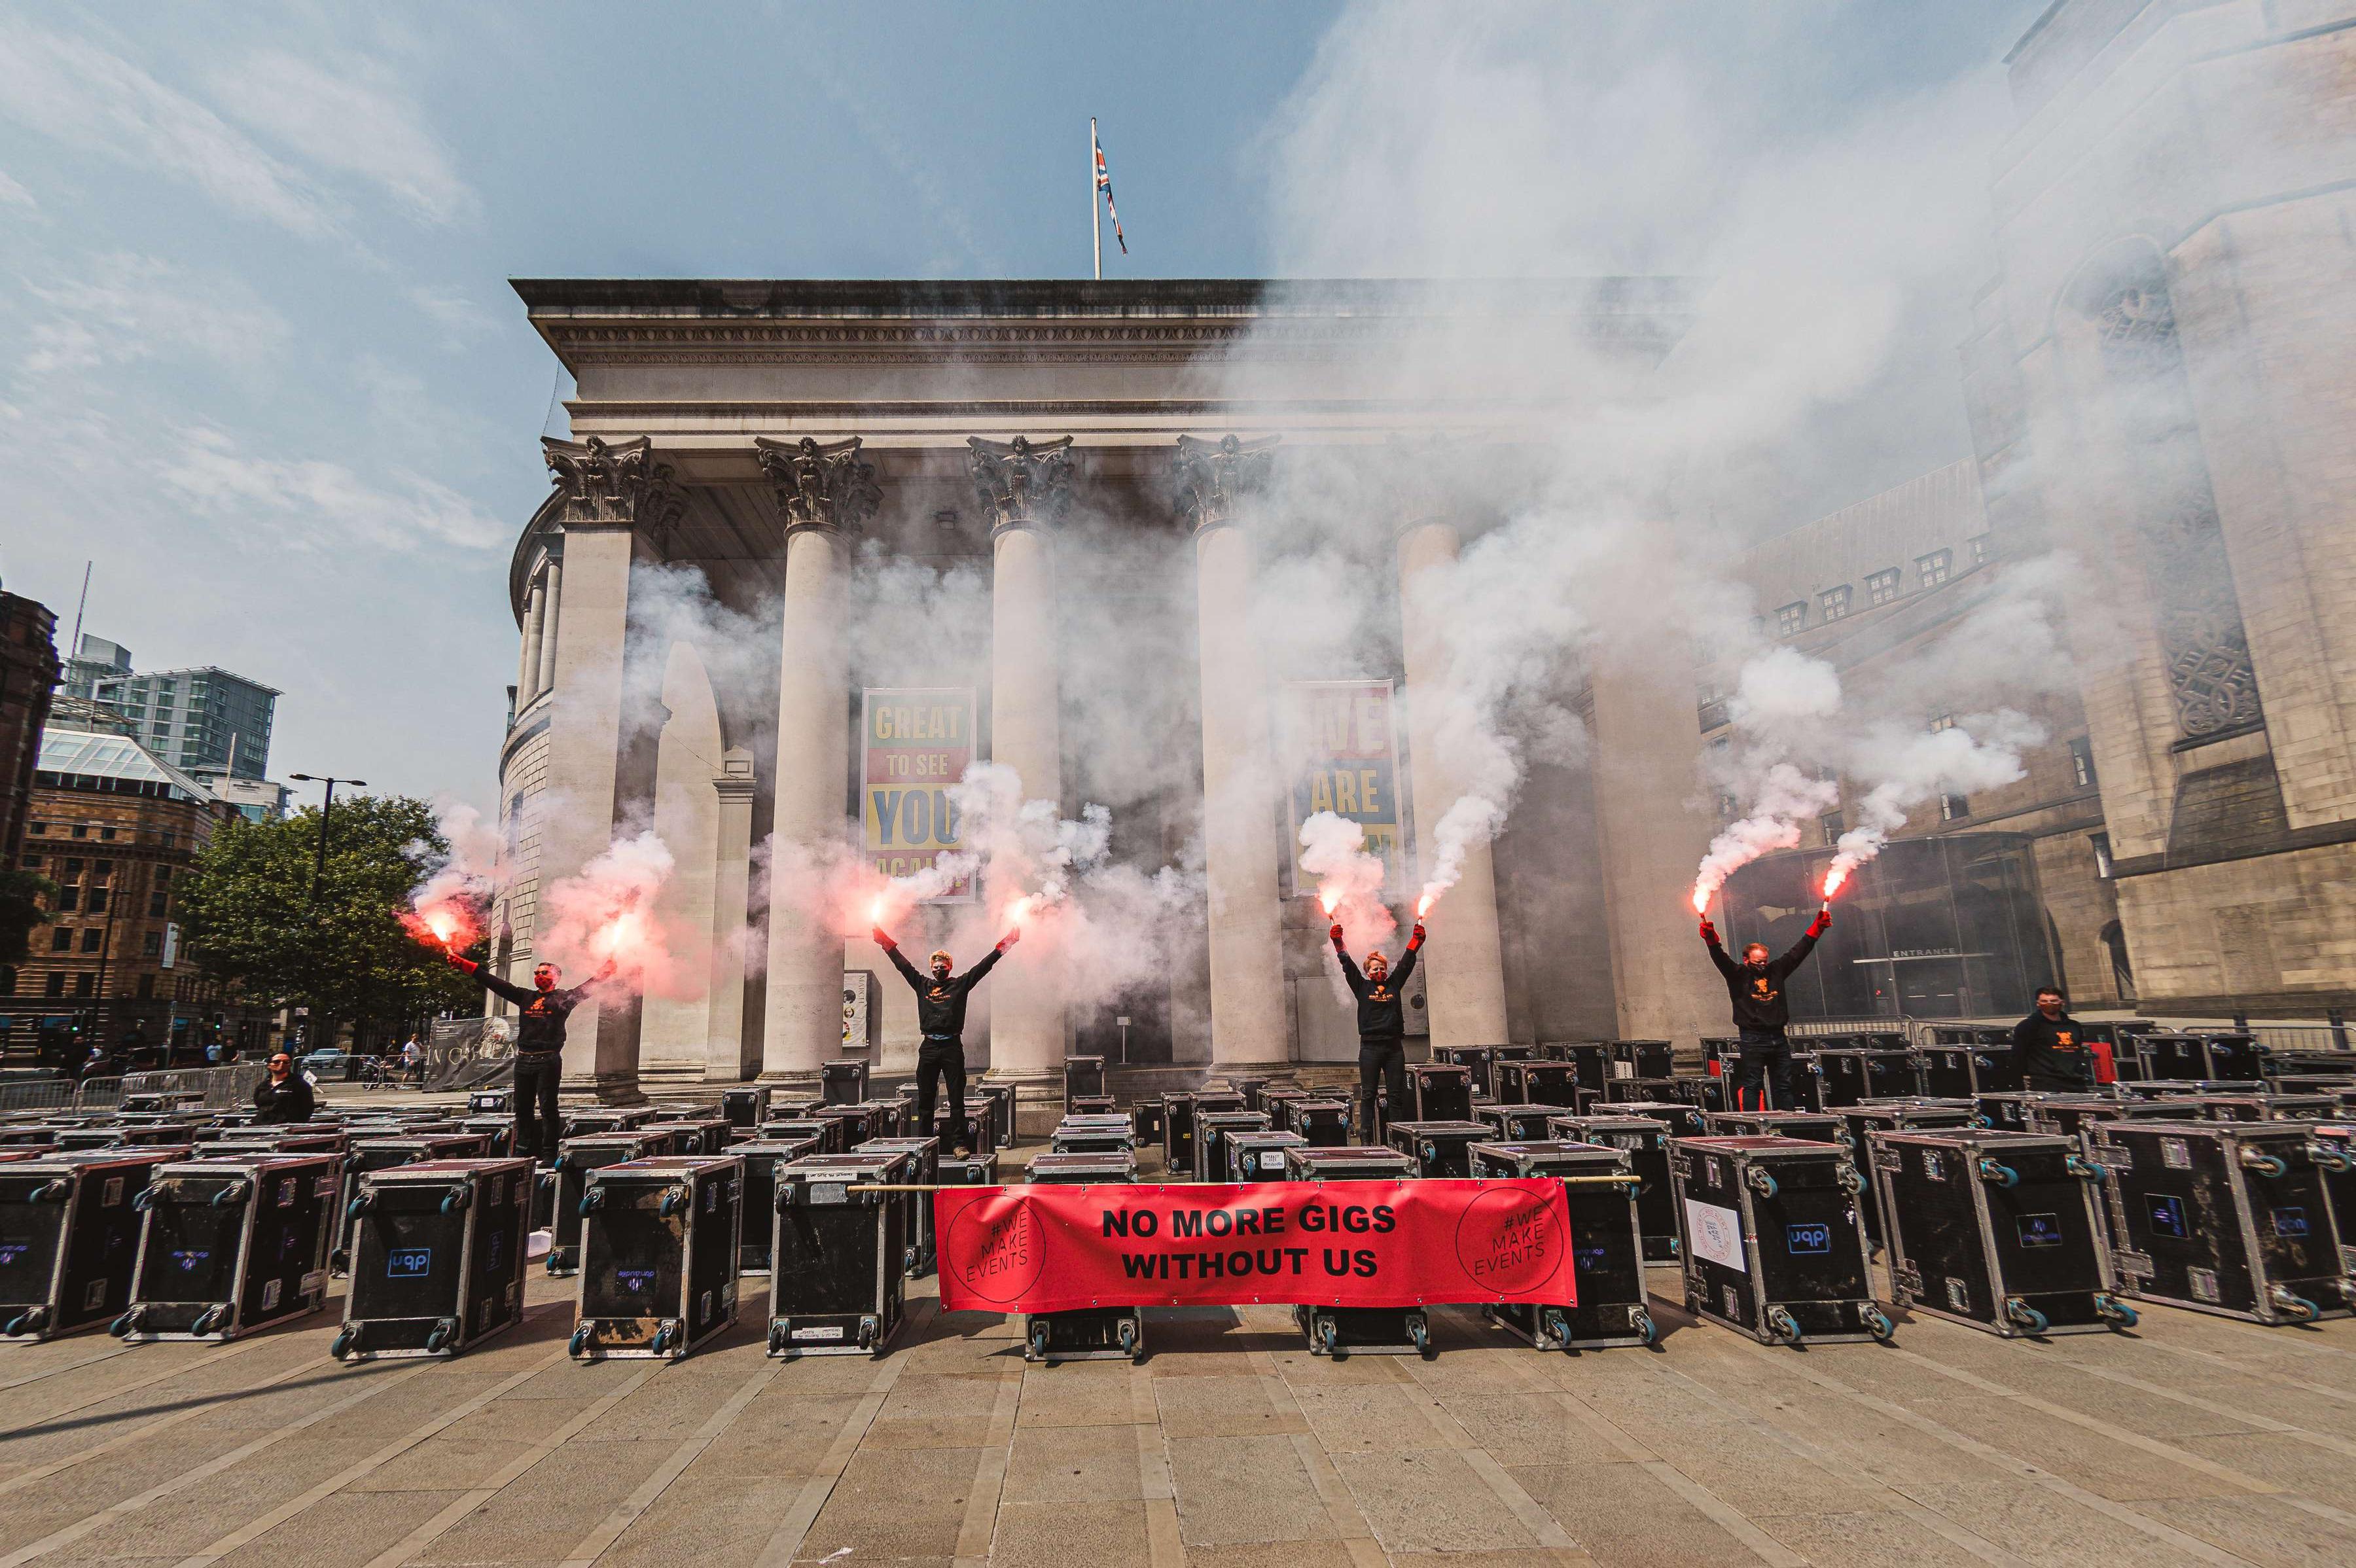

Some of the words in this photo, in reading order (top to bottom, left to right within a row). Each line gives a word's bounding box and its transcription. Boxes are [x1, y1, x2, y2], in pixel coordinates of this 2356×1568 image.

[875, 705, 962, 739] GREAT
[887, 755, 910, 775] TO
[916, 754, 948, 775] SEE
[1311, 769, 1380, 813] ARE
[873, 790, 960, 845] YOU
[1893, 948, 1955, 957] ENTRANCE
[991, 1211, 1027, 1237] #WE
[1103, 1210, 1158, 1238] NO
[1173, 1208, 1285, 1238] MORE
[1299, 1205, 1396, 1234] GIGS
[1505, 1205, 1543, 1230] #WE
[981, 1230, 1027, 1256] MAKE
[1492, 1225, 1544, 1251] MAKE
[965, 1249, 1028, 1283] EVENTS
[1122, 1248, 1308, 1279] WITHOUT
[1323, 1249, 1378, 1277] US
[1475, 1243, 1544, 1275] EVENTS
